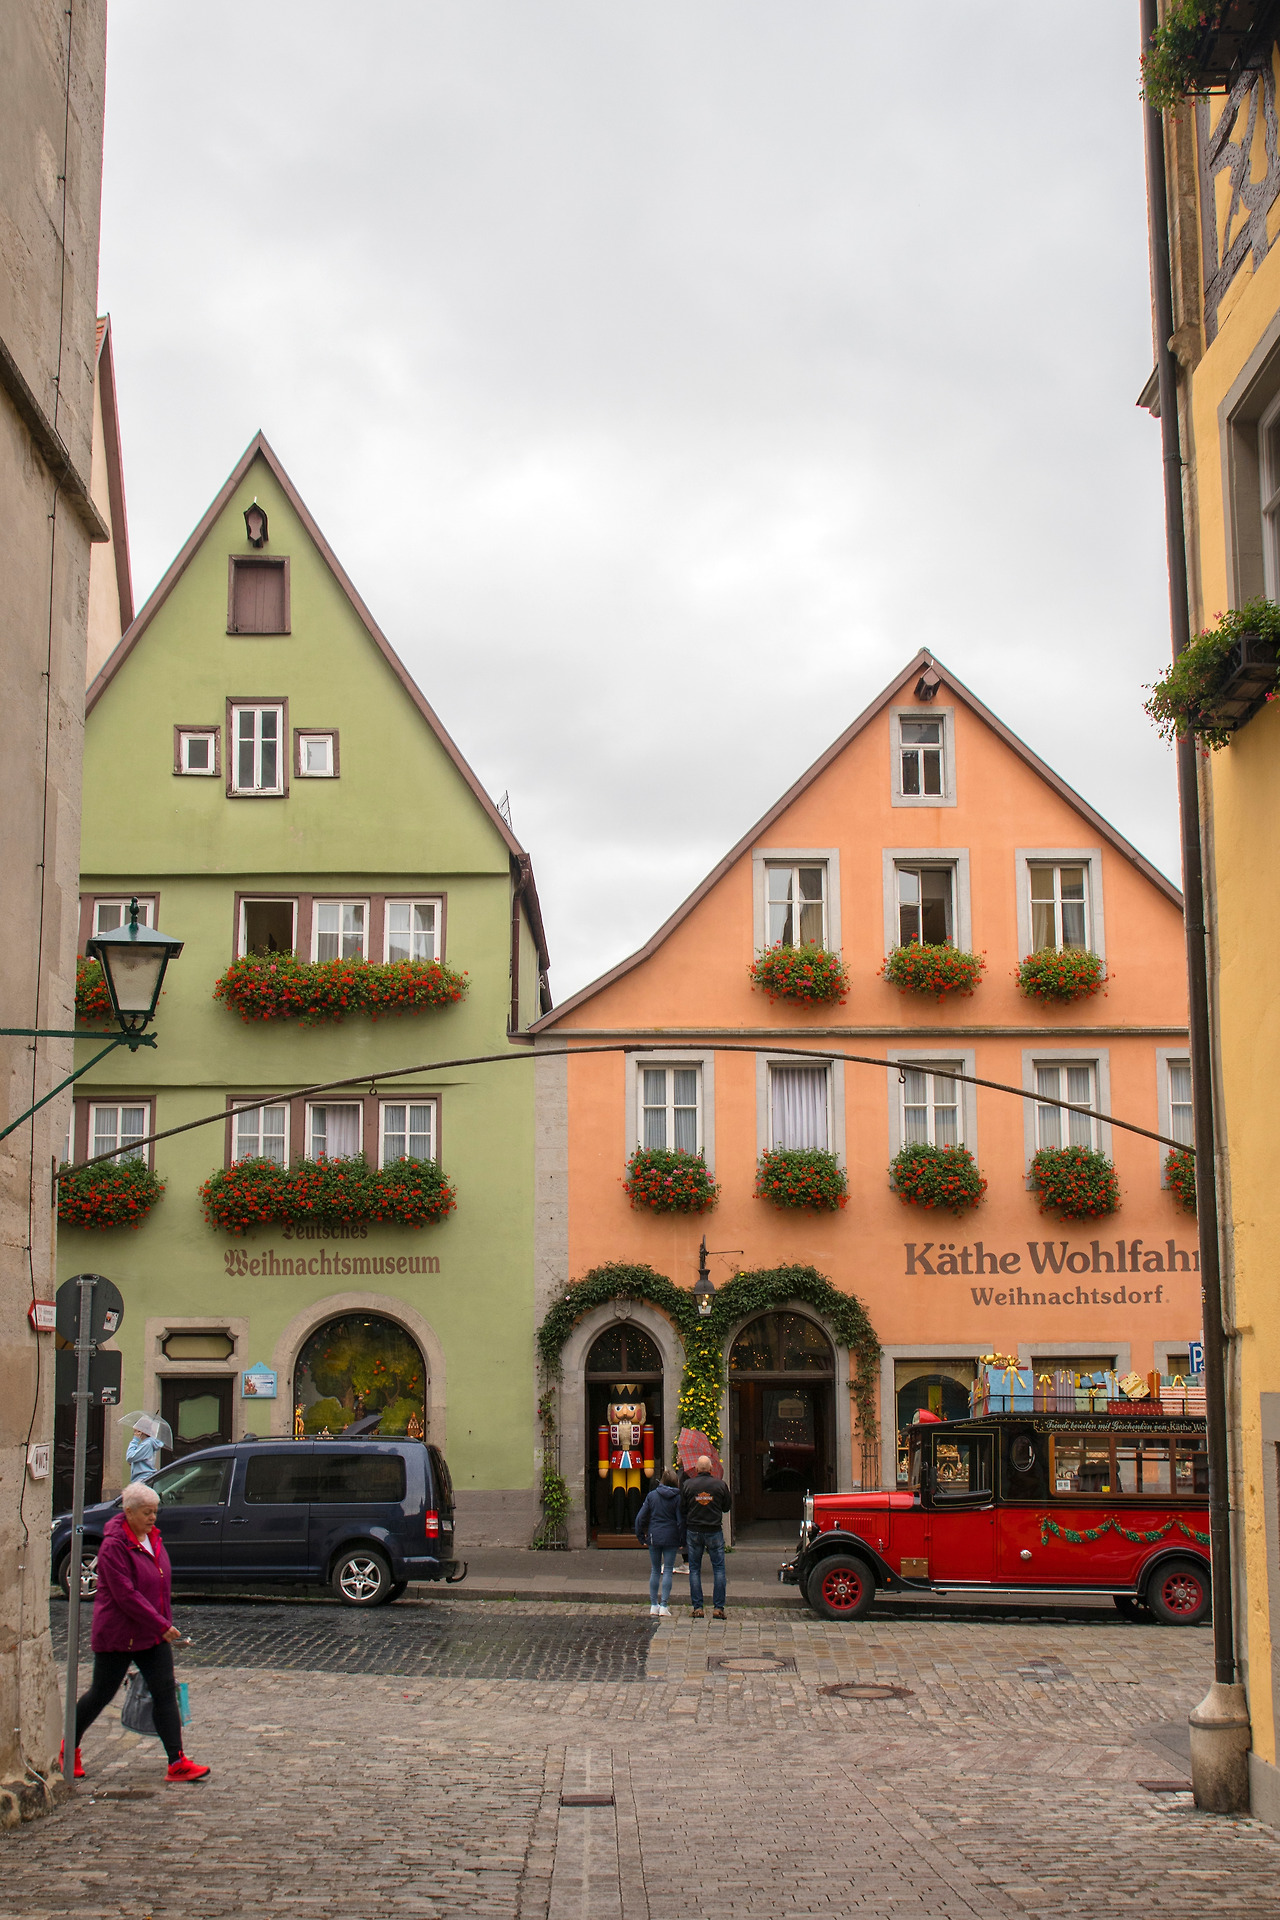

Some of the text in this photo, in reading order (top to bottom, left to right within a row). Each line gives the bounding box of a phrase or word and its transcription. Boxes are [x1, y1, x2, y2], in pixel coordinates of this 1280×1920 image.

[282, 1220, 368, 1240] Deutsches
[224, 1249, 441, 1277] Weihnachtsmuseum
[904, 1241, 1021, 1275] Käthe
[970, 1284, 1163, 1306] Weihnachtsdorf
[1192, 1346, 1204, 1372] P
[1169, 1421, 1192, 1431] Käthe
